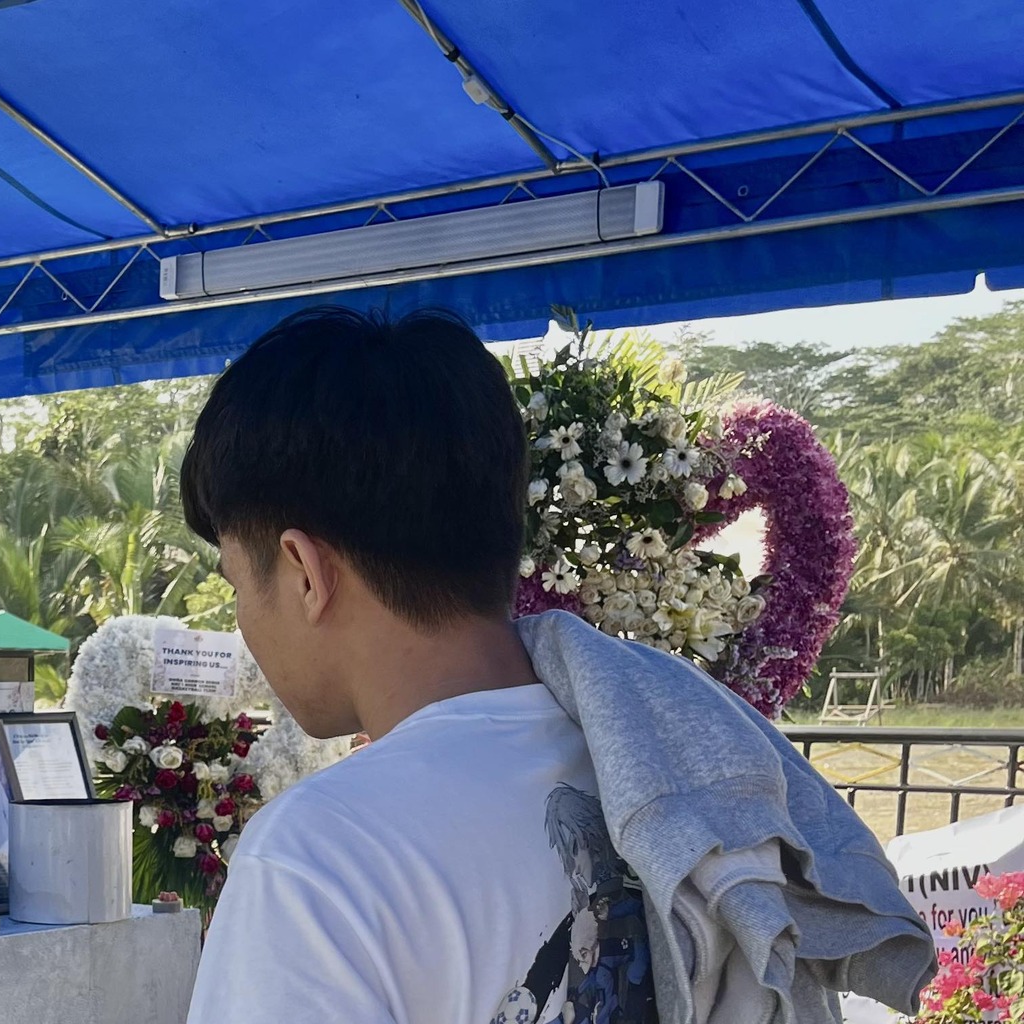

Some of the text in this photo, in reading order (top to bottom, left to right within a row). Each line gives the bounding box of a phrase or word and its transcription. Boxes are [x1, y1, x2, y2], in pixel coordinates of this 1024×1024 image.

[162, 648, 194, 656] THANK
[164, 659, 208, 668] INSPIRING
[931, 904, 954, 930] for
